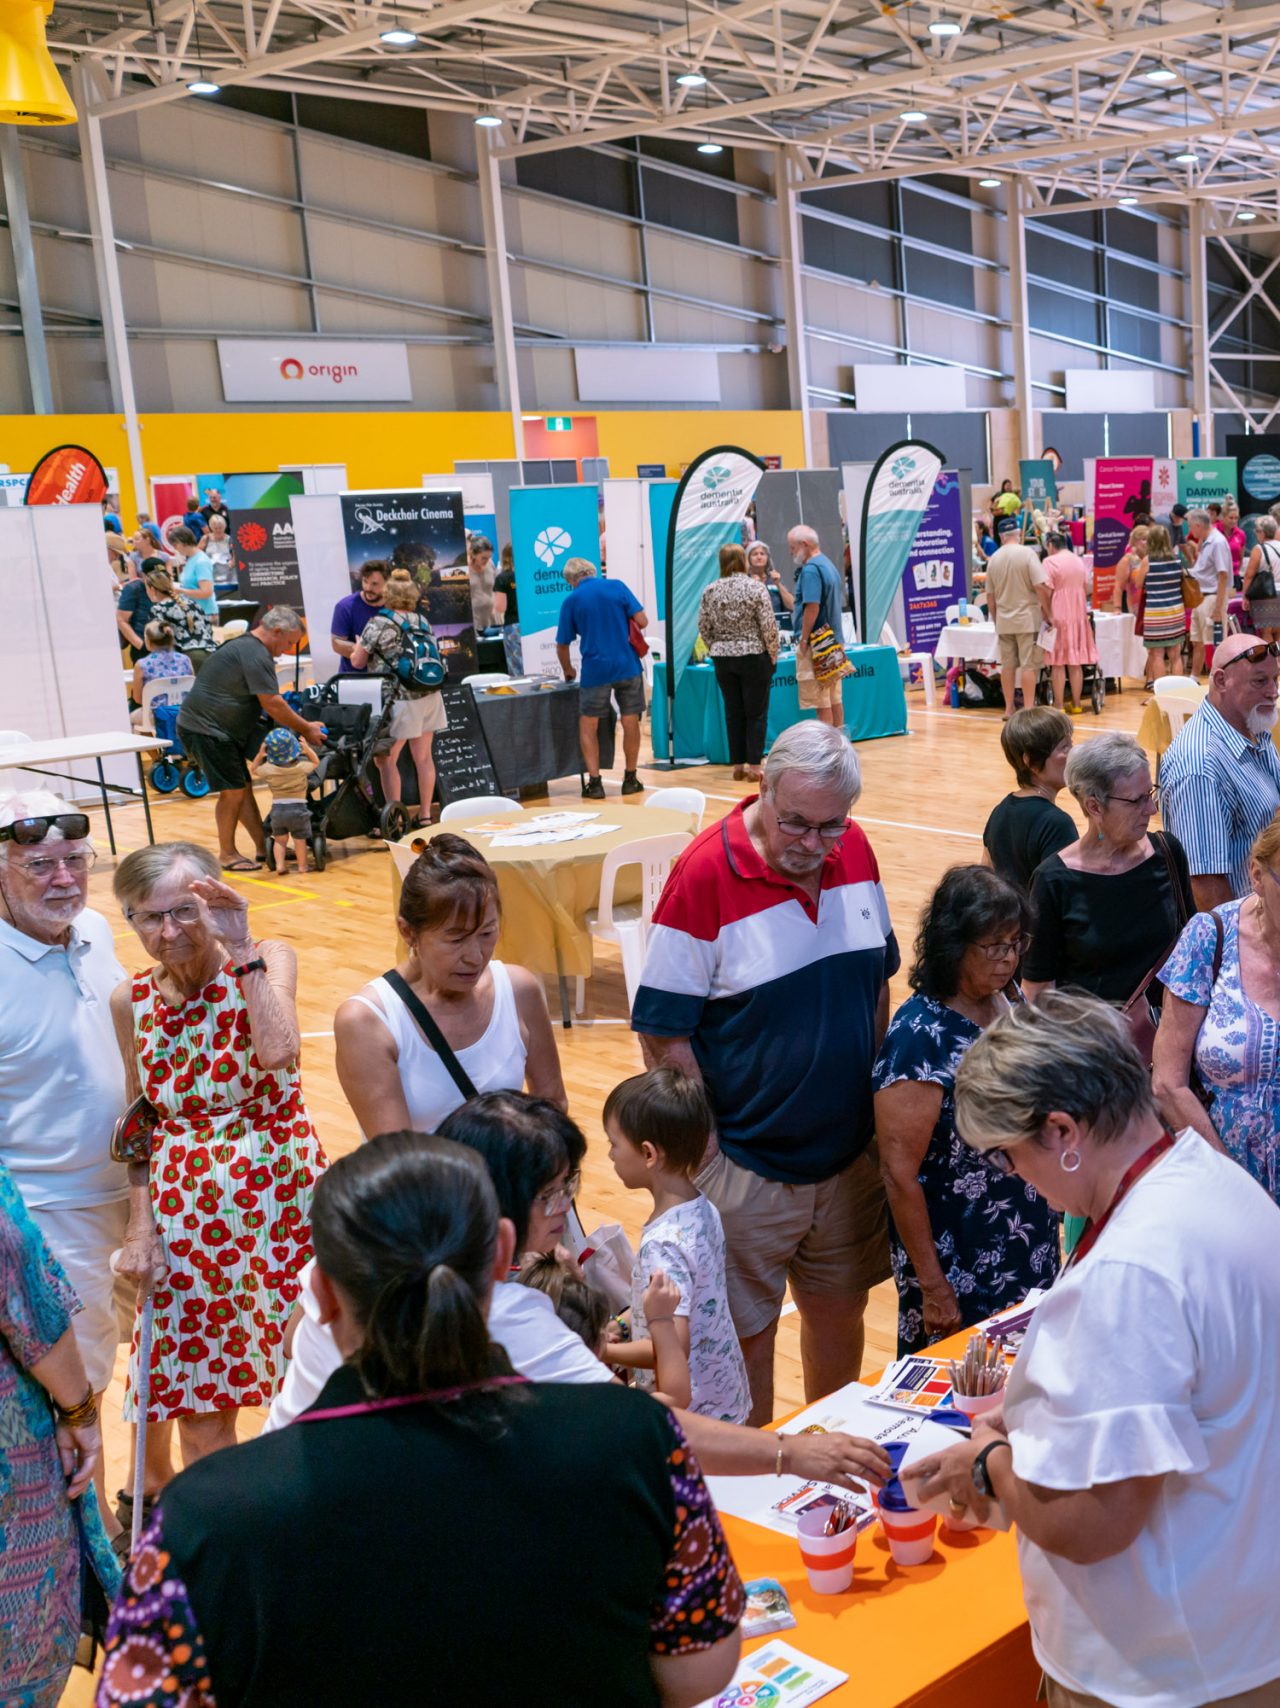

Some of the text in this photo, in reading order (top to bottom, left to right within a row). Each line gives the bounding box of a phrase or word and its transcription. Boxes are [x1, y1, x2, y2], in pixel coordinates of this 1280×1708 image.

[308, 365, 358, 384] origin
[0, 478, 27, 487] RSPC
[889, 479, 925, 488] dementia
[700, 488, 743, 501] dementia
[889, 487, 922, 497] australia
[1186, 487, 1229, 497] DARWIN
[700, 498, 740, 509] australia
[376, 508, 454, 521] Deckchair Cinema
[272, 523, 294, 535] AA
[916, 528, 953, 537] erstanding,
[919, 547, 955, 556] connection
[535, 580, 573, 595] austra
